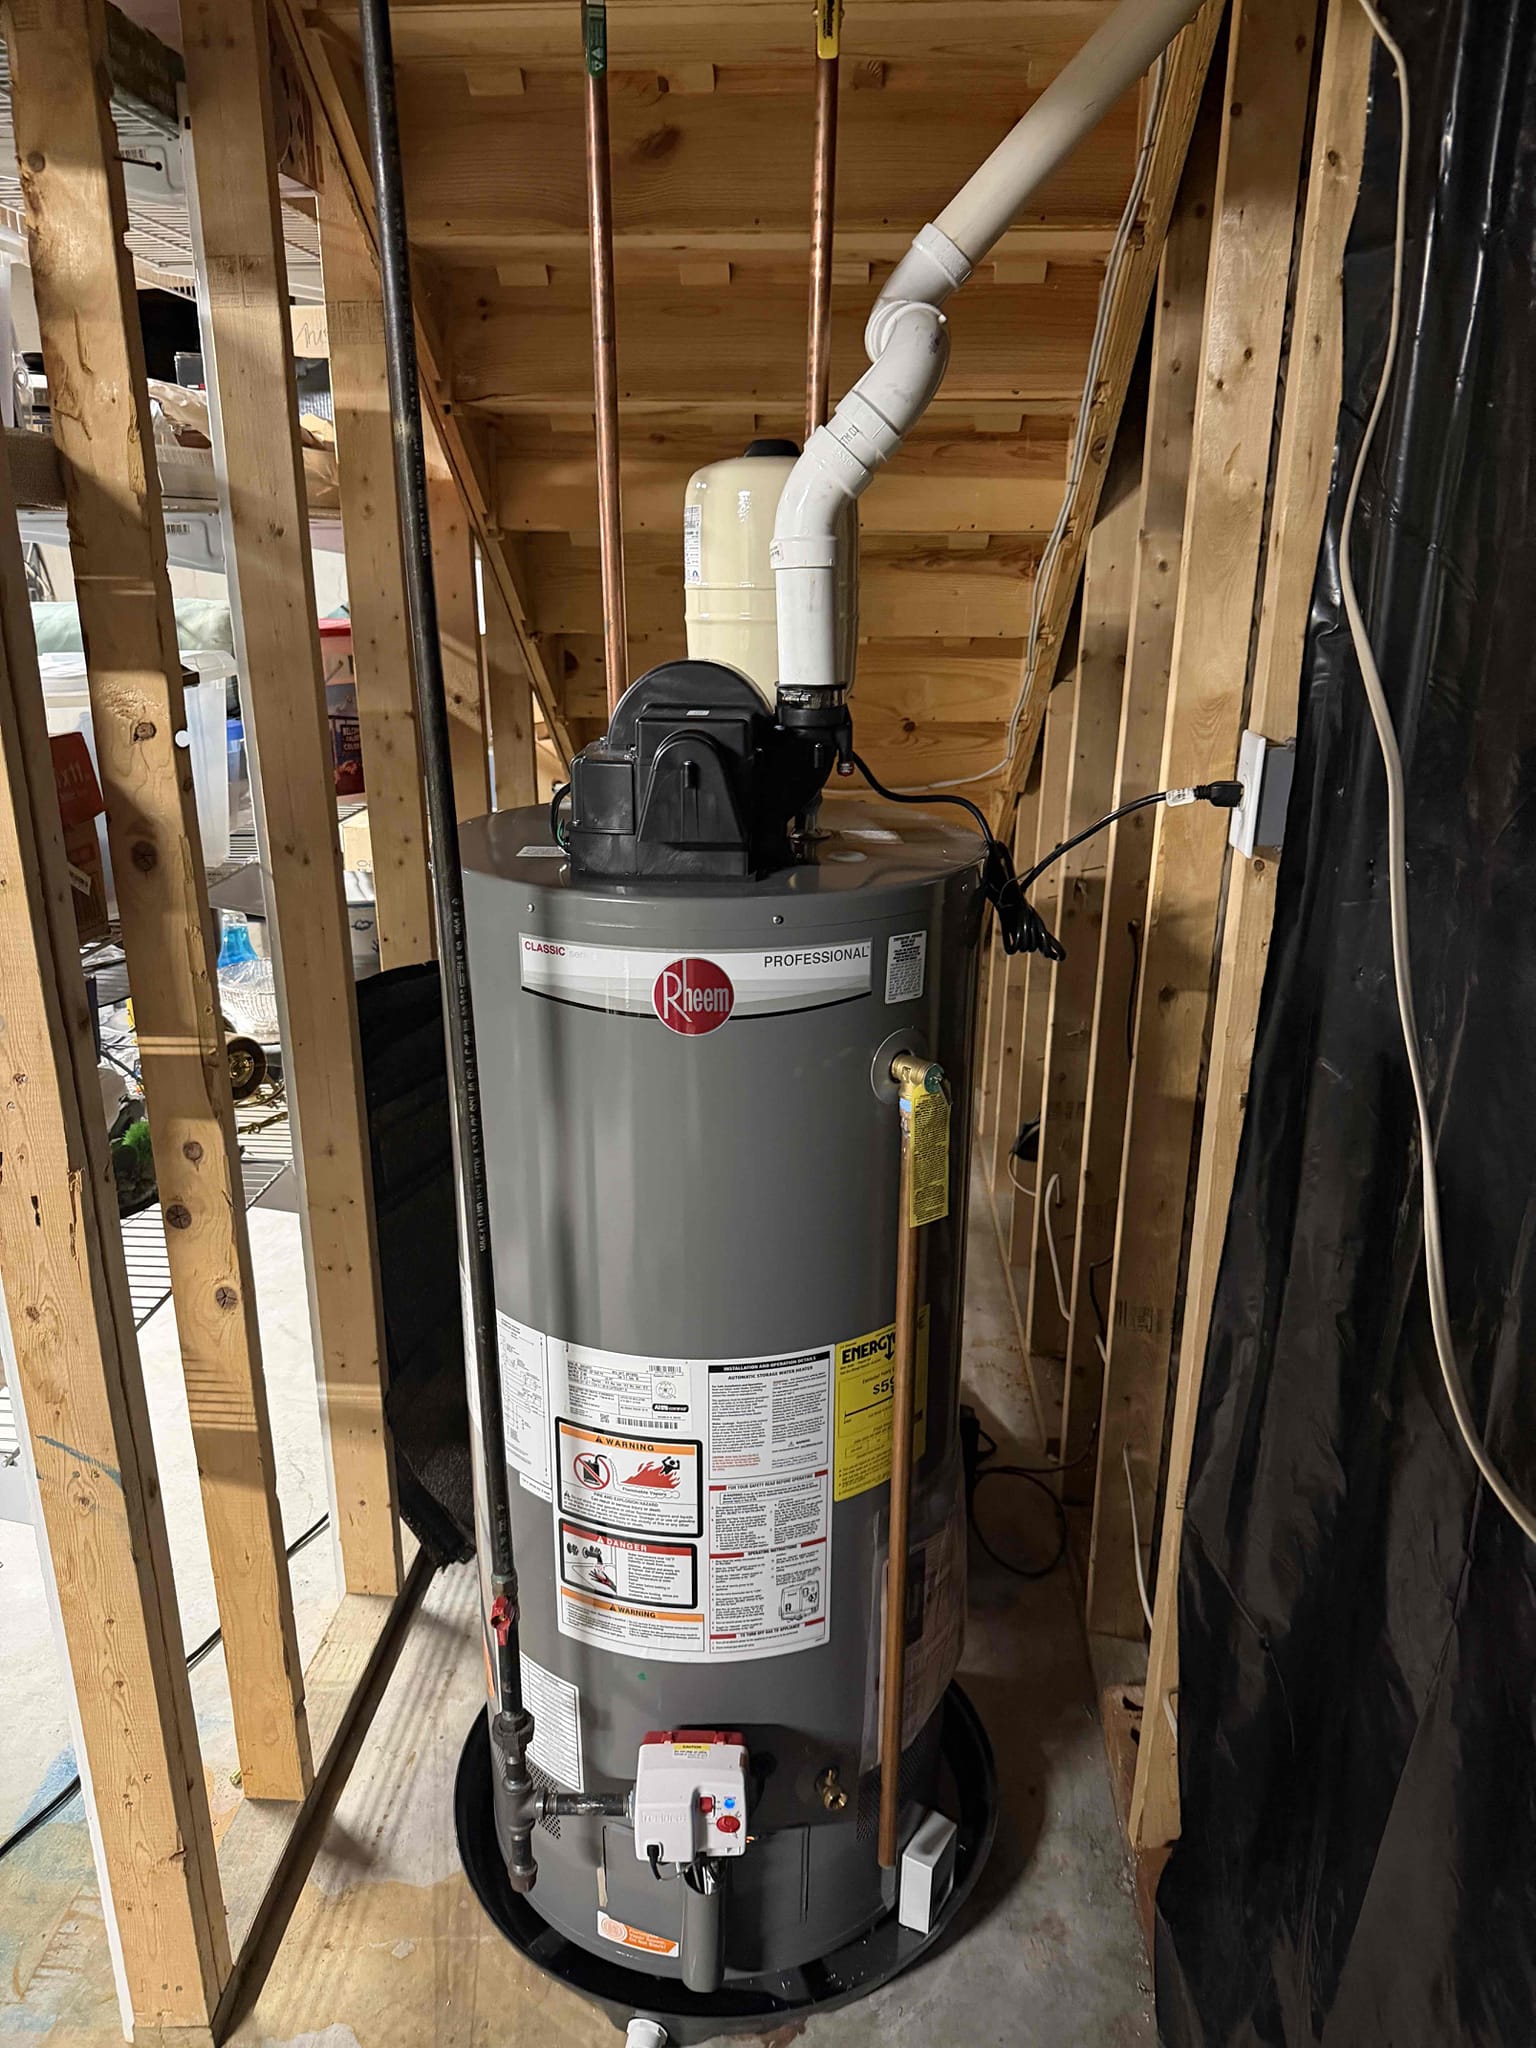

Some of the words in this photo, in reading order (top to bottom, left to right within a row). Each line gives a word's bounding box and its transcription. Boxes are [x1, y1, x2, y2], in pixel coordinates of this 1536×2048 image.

[524, 941, 565, 956] CLASSIC
[764, 946, 868, 968] PROFESSIONAL
[663, 958, 729, 1022] Rheem
[723, 1364, 758, 1372] INSTALLATION
[771, 1359, 797, 1368] OPERATION
[605, 1438, 654, 1452] WARNING
[606, 1539, 647, 1552] DANGER
[618, 1607, 656, 1619] WARNING
